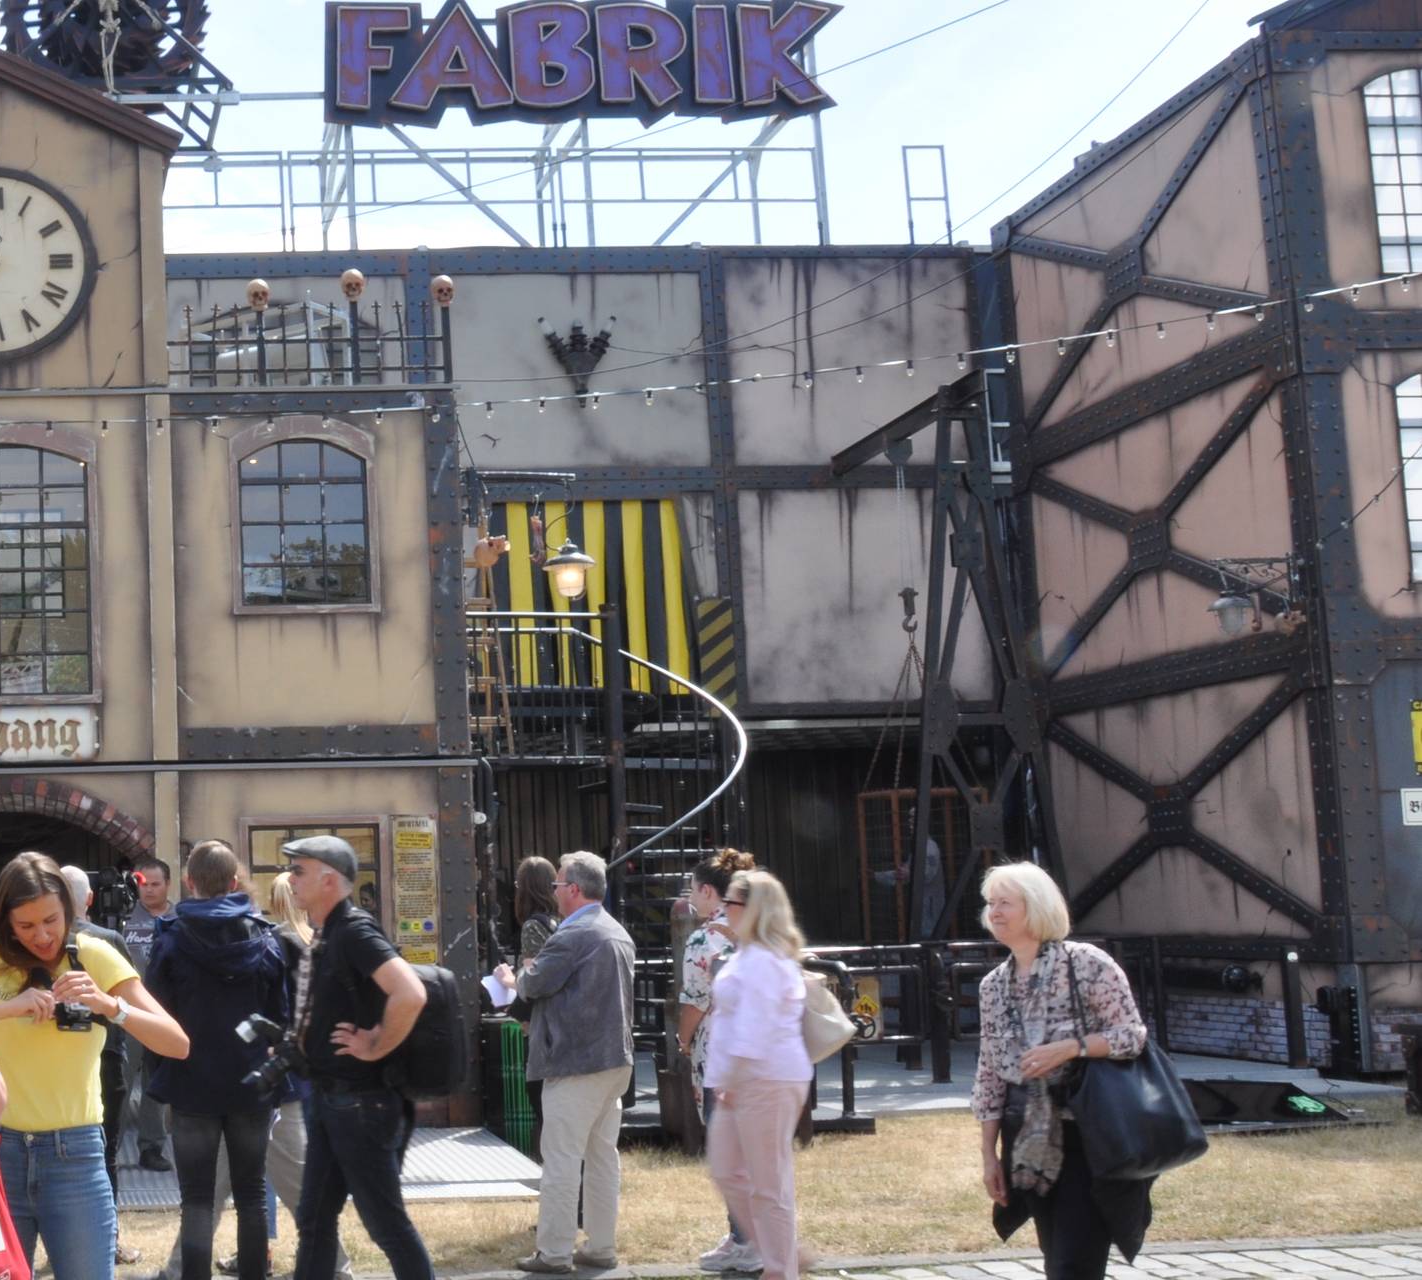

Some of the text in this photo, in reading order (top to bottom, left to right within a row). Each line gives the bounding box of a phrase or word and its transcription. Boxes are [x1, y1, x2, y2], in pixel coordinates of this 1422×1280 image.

[336, 3, 831, 111] FABRIK
[38, 219, 62, 239] II
[49, 253, 73, 269] III
[40, 281, 68, 308] IV
[20, 308, 41, 333] V
[125, 931, 154, 943] Hard
